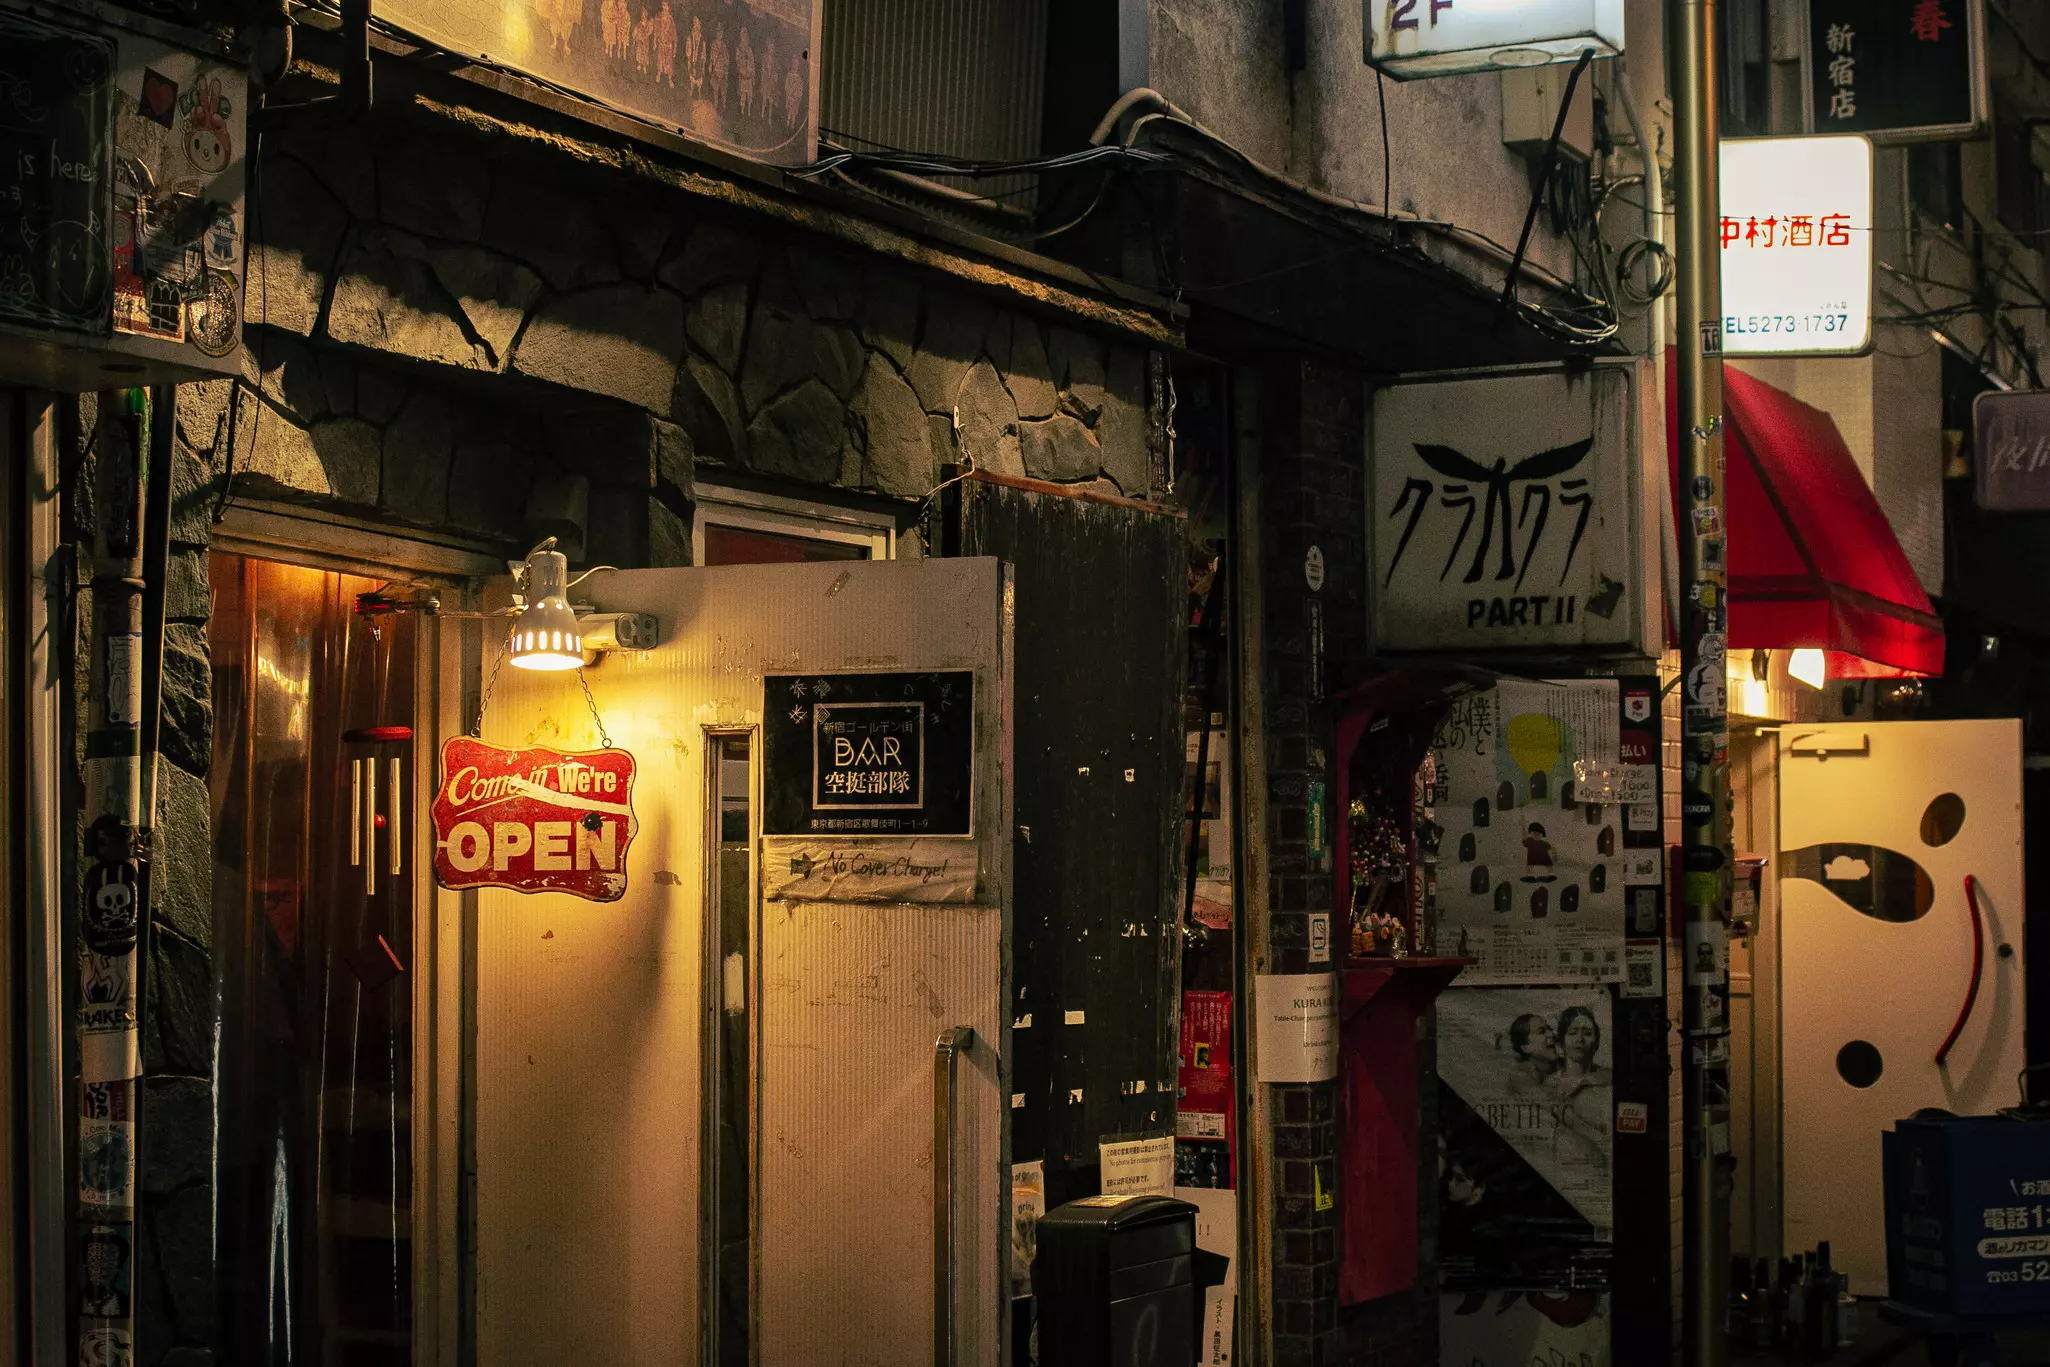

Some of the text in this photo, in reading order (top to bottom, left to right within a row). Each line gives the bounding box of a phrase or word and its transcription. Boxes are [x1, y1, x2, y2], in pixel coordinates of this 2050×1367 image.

[1825, 22, 1857, 119] 新宿店
[1720, 213, 1851, 249] 中村酒店
[1467, 595, 1577, 628] PART II
[834, 736, 903, 767] BAR
[447, 765, 617, 807] Come in We're
[824, 771, 911, 795] 空挺部隊
[446, 821, 617, 873] OPEN
[824, 851, 847, 875] No
[851, 853, 888, 876] Cover
